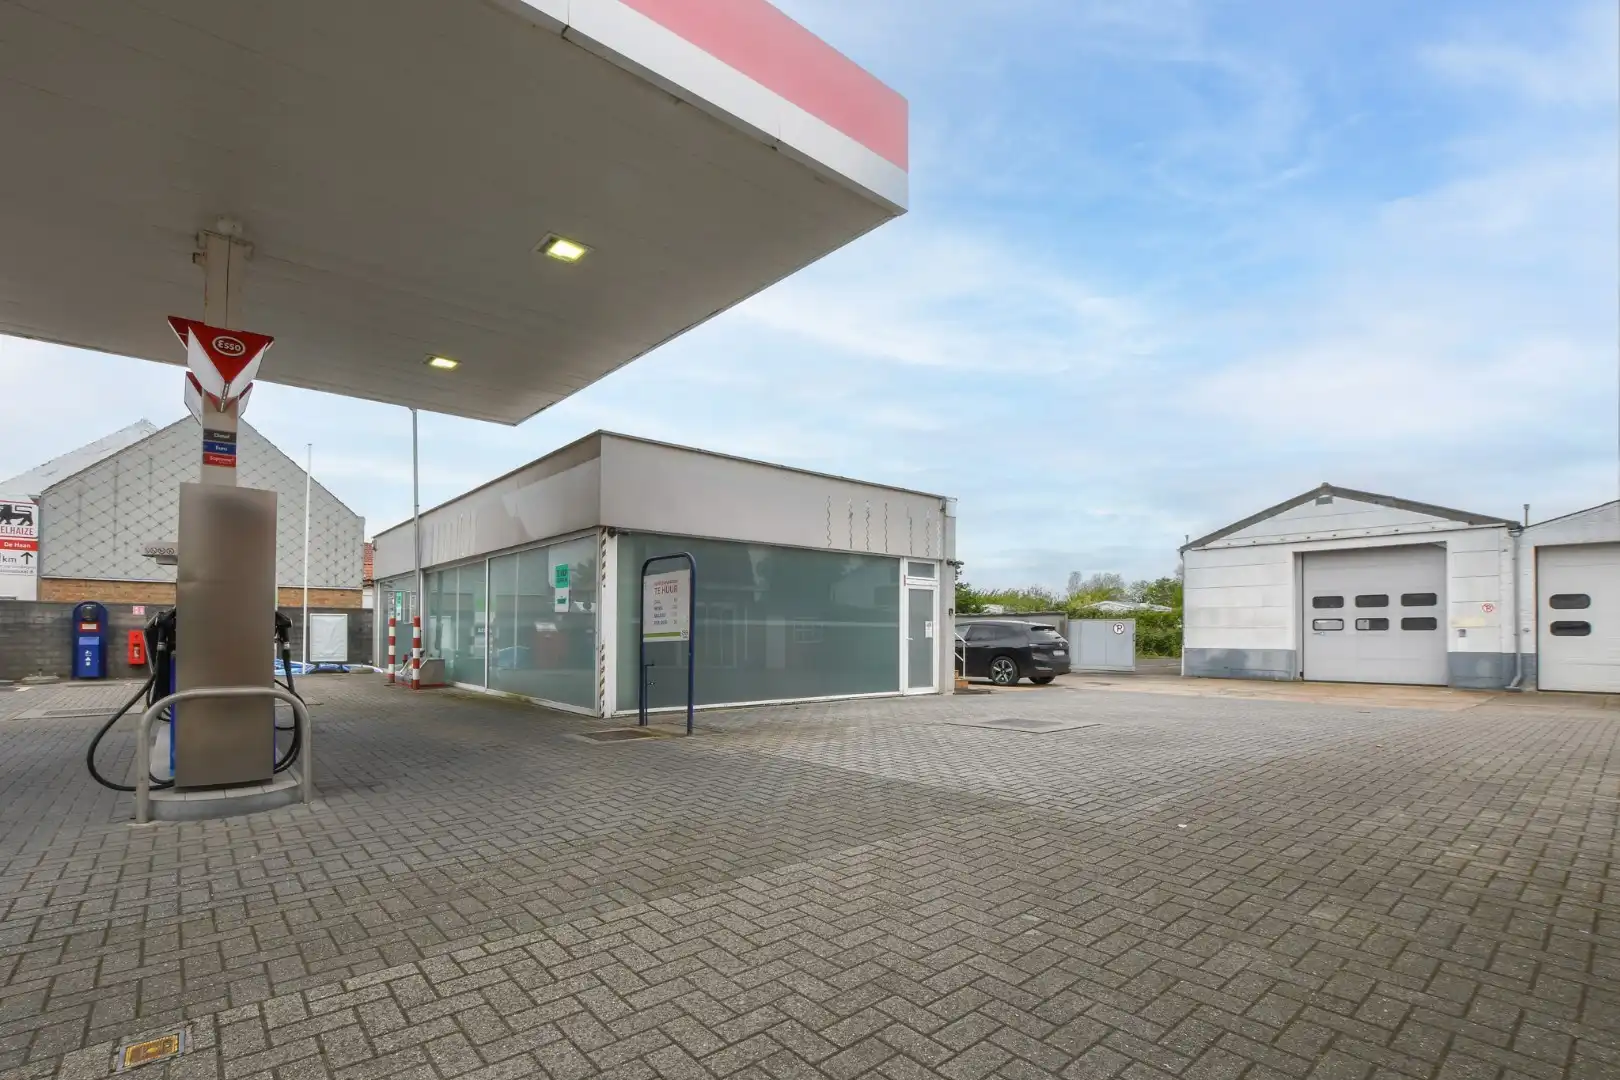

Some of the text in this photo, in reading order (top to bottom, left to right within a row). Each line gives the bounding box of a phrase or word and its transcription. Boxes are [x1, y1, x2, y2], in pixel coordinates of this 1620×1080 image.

[0, 526, 34, 535] ELHAIZE
[654, 585, 678, 595] TE HUUR
